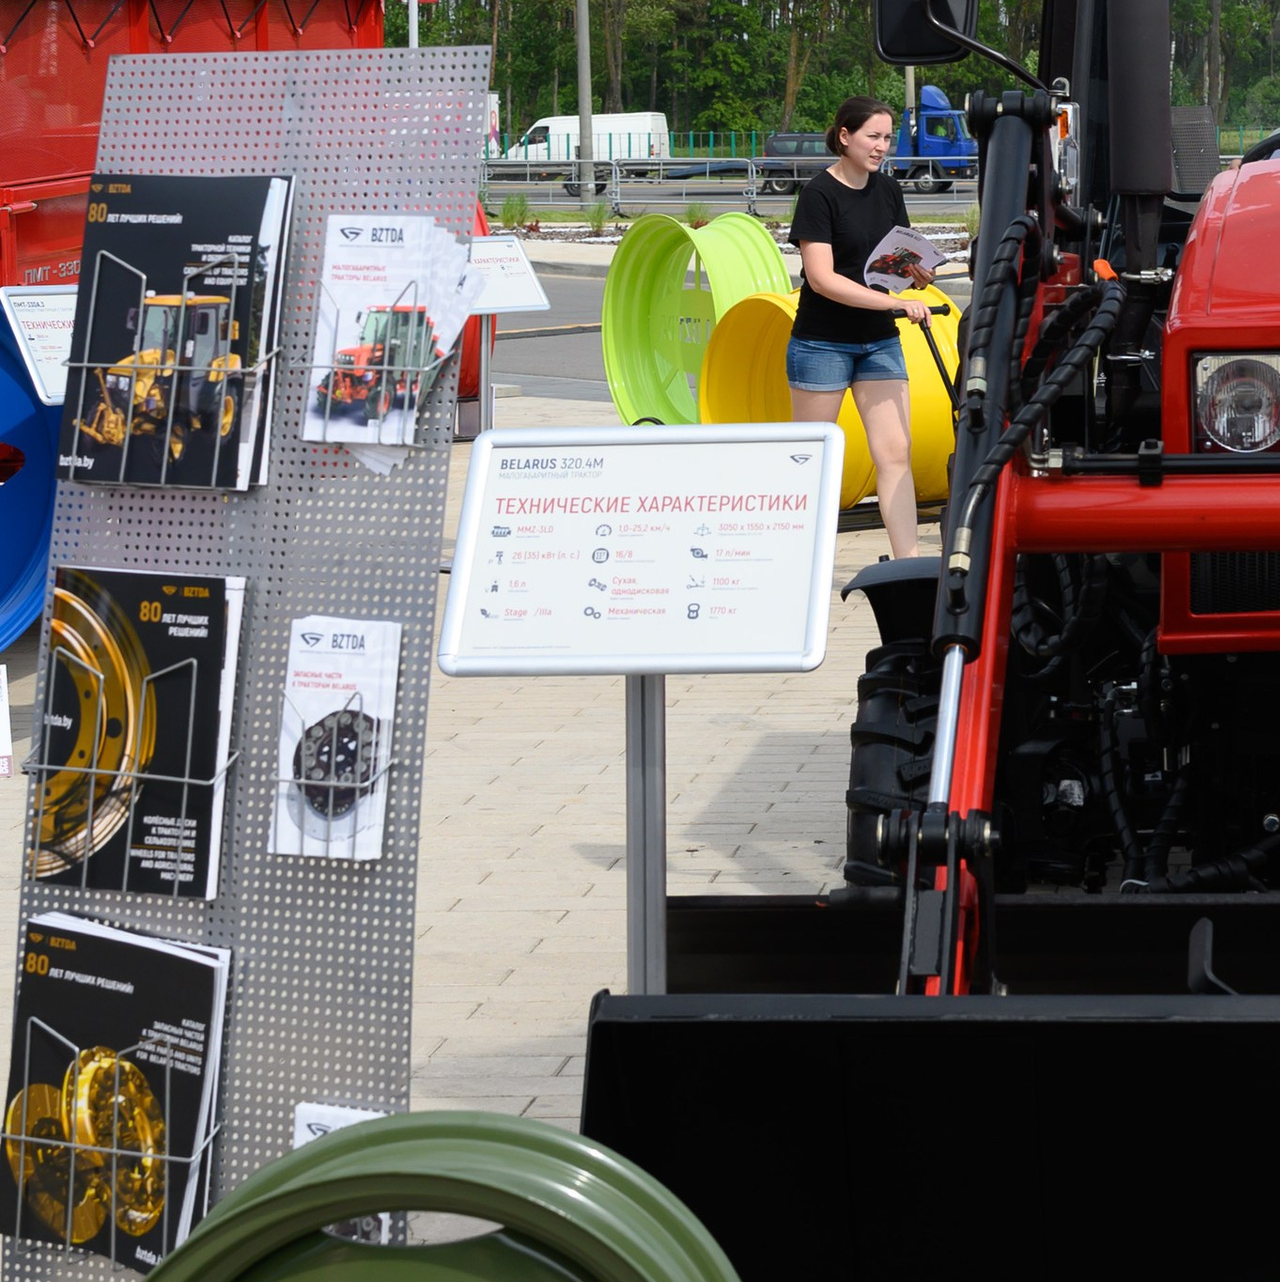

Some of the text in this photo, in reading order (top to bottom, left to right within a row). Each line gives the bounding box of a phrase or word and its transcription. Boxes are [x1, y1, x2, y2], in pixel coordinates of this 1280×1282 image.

[88, 202, 108, 223] 80
[371, 227, 404, 243] BZTDA
[501, 458, 557, 470] BELARUS
[571, 471, 603, 479] ТРАКТОР
[496, 494, 808, 515] ТЕХНИЧЕСКИЕ ХАРАКТЕРИСТИКИ
[650, 523, 671, 533] км/ч
[718, 523, 738, 531] 3050
[747, 523, 764, 531] 1550
[772, 522, 790, 530] 2150
[512, 552, 523, 560] 26
[541, 552, 556, 560] кВт
[615, 550, 633, 559] 16/8
[725, 548, 751, 557] л/мин
[509, 580, 519, 588] 1,6
[612, 588, 670, 596] однодисковая
[139, 600, 162, 623] 80
[505, 608, 527, 617] Stage
[608, 607, 666, 616] Механическая
[331, 633, 365, 650] BZTDA
[49, 936, 77, 951] BZTDA
[25, 952, 49, 976] 80
